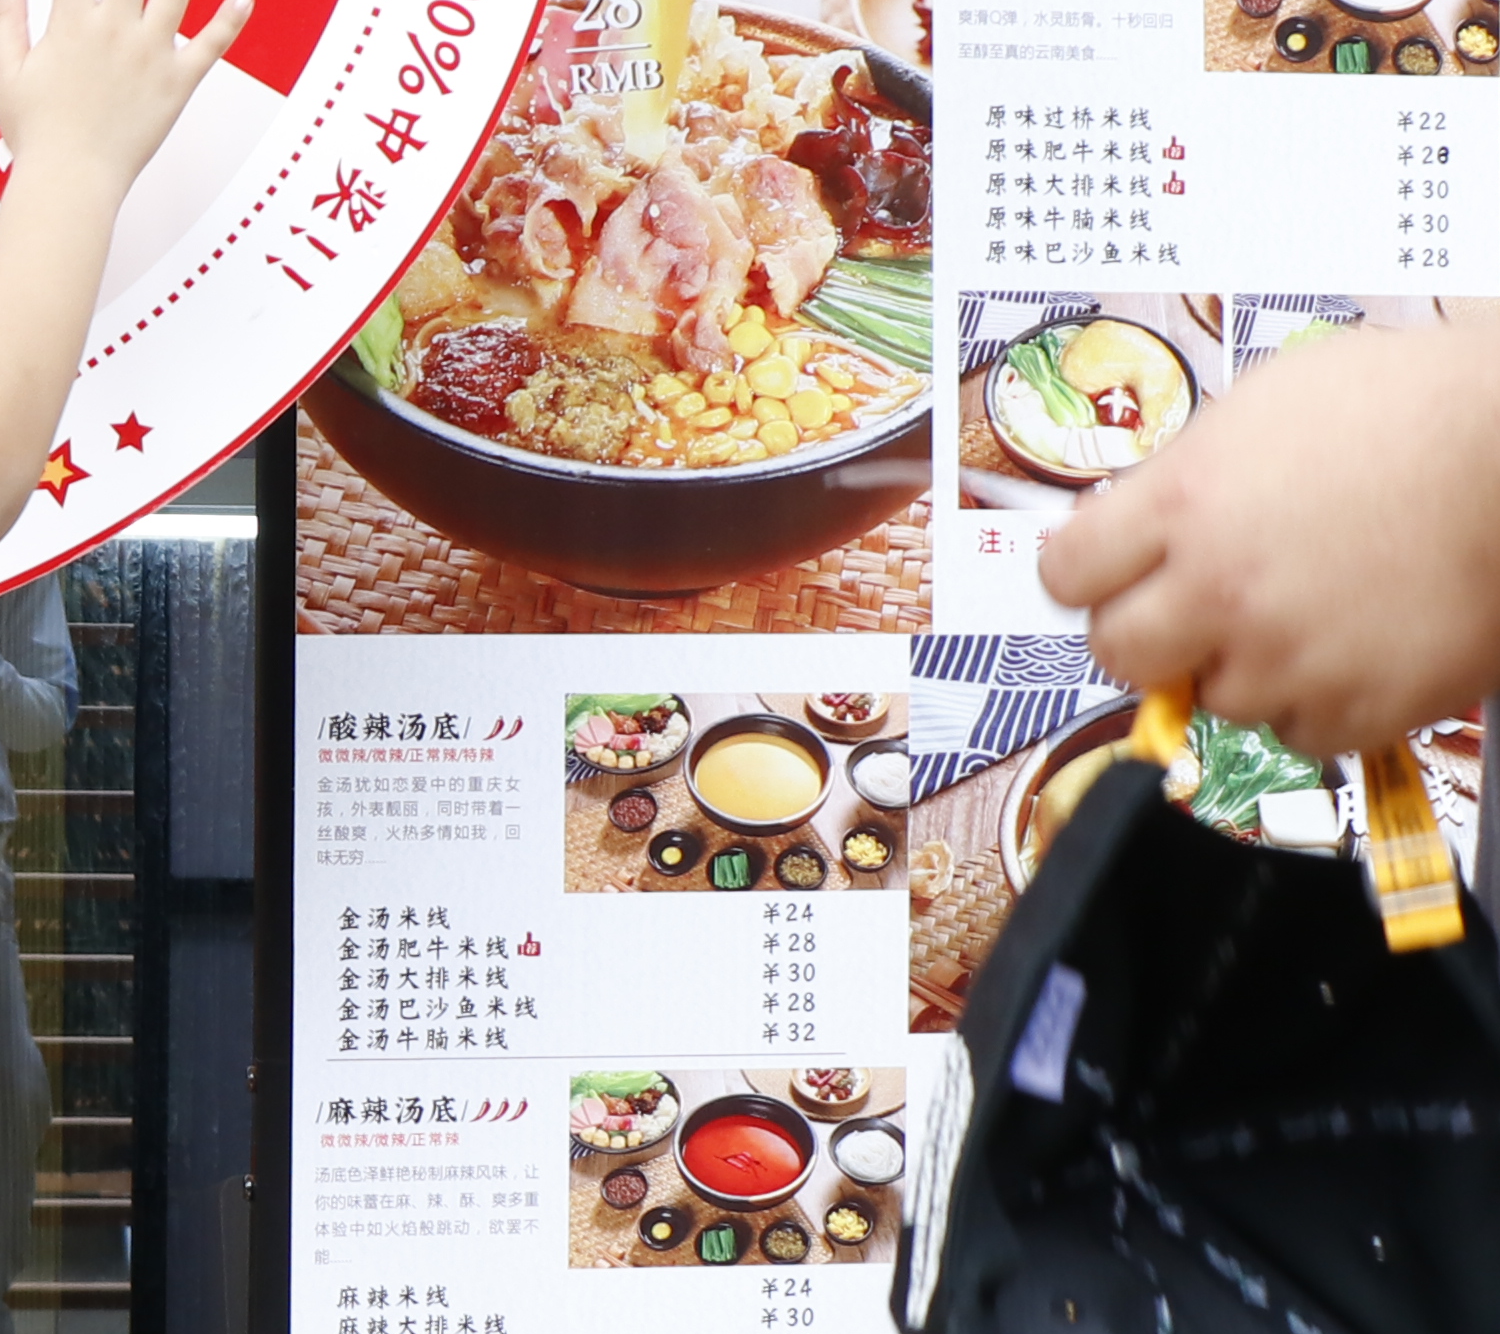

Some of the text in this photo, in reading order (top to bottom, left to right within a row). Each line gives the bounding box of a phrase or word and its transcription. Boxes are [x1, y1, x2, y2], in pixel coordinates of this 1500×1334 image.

[570, 59, 663, 96] RMB
[985, 104, 1152, 131] 原味过桥米线
[985, 138, 1152, 165] 原味肥牛米线
[985, 172, 1152, 198] 原味大排米线
[985, 206, 1152, 232] 原味牛腩米线
[985, 239, 1181, 266] 原味巴沙鱼米线
[339, 906, 451, 931] 金汤米线
[339, 935, 509, 962] 金汤肥牛米线
[339, 965, 509, 992] 金汤大排米线
[339, 995, 538, 1022] 金汤巴沙鱼米线
[339, 1026, 509, 1053] 金汤牛腩米线
[336, 1285, 450, 1310] 麻辣米线
